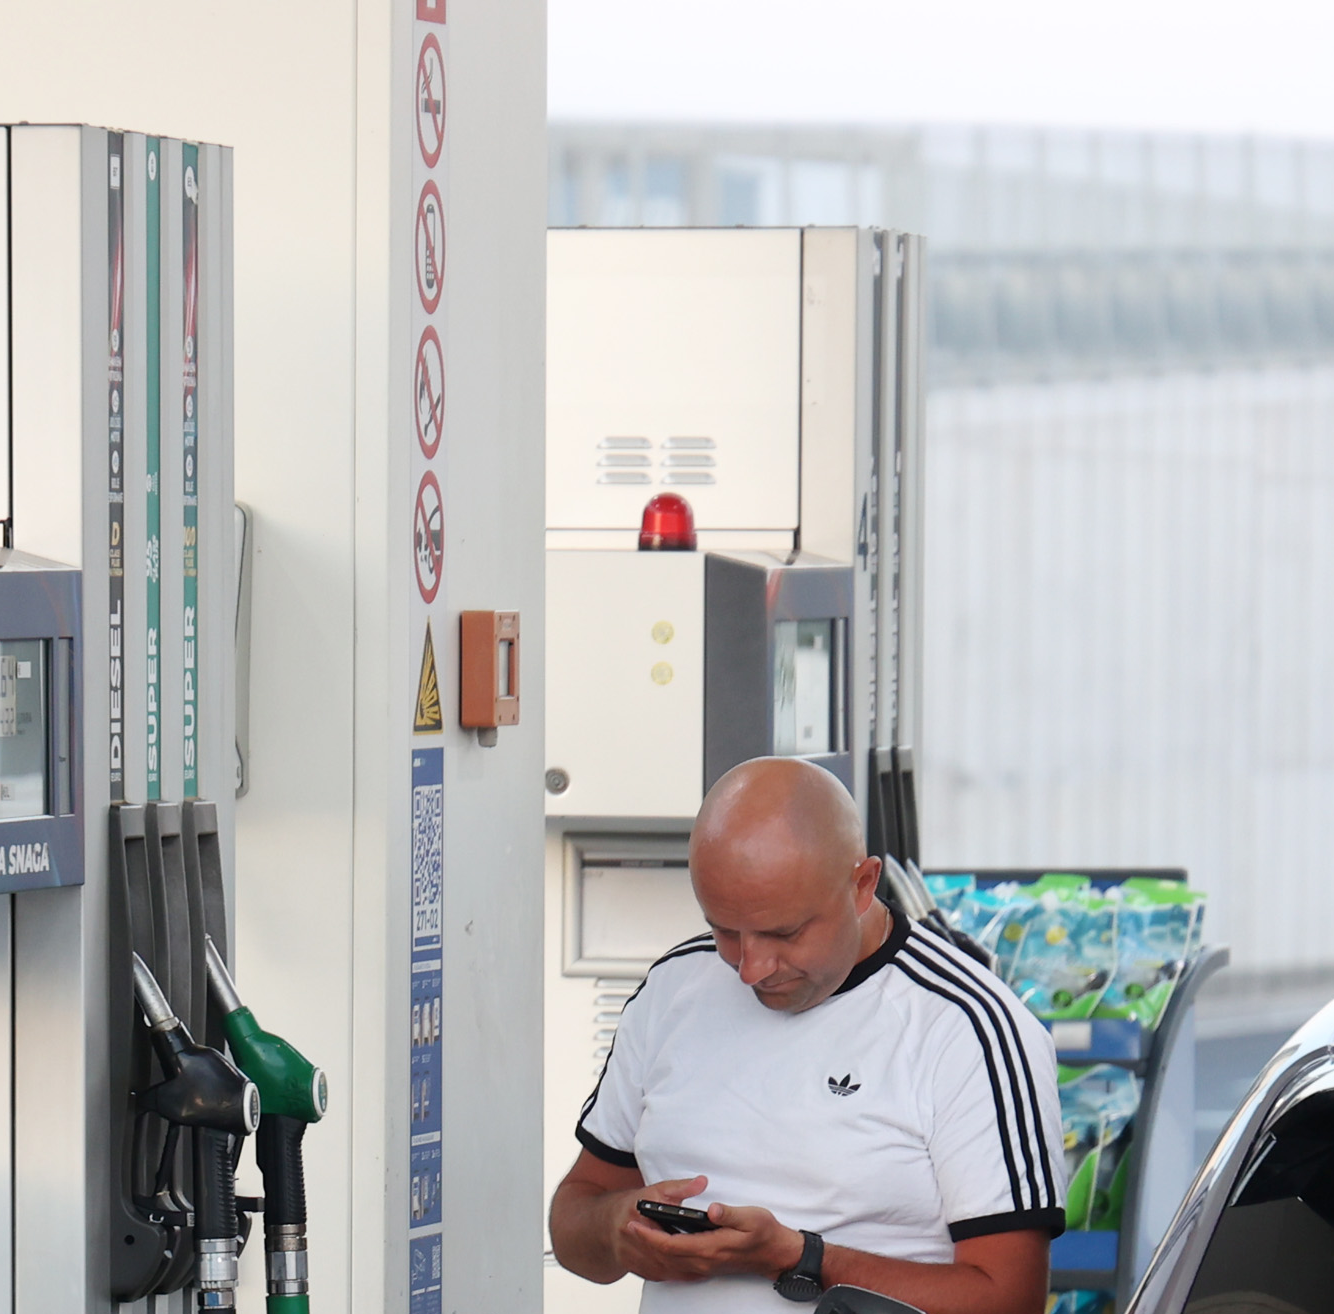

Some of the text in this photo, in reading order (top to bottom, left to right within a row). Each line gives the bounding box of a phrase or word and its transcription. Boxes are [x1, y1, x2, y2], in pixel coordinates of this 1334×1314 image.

[111, 521, 120, 545] D
[110, 599, 122, 769] DIESEL
[147, 628, 157, 771] SUPER
[184, 606, 195, 767] SUPER
[8, 842, 49, 876] SNAGA
